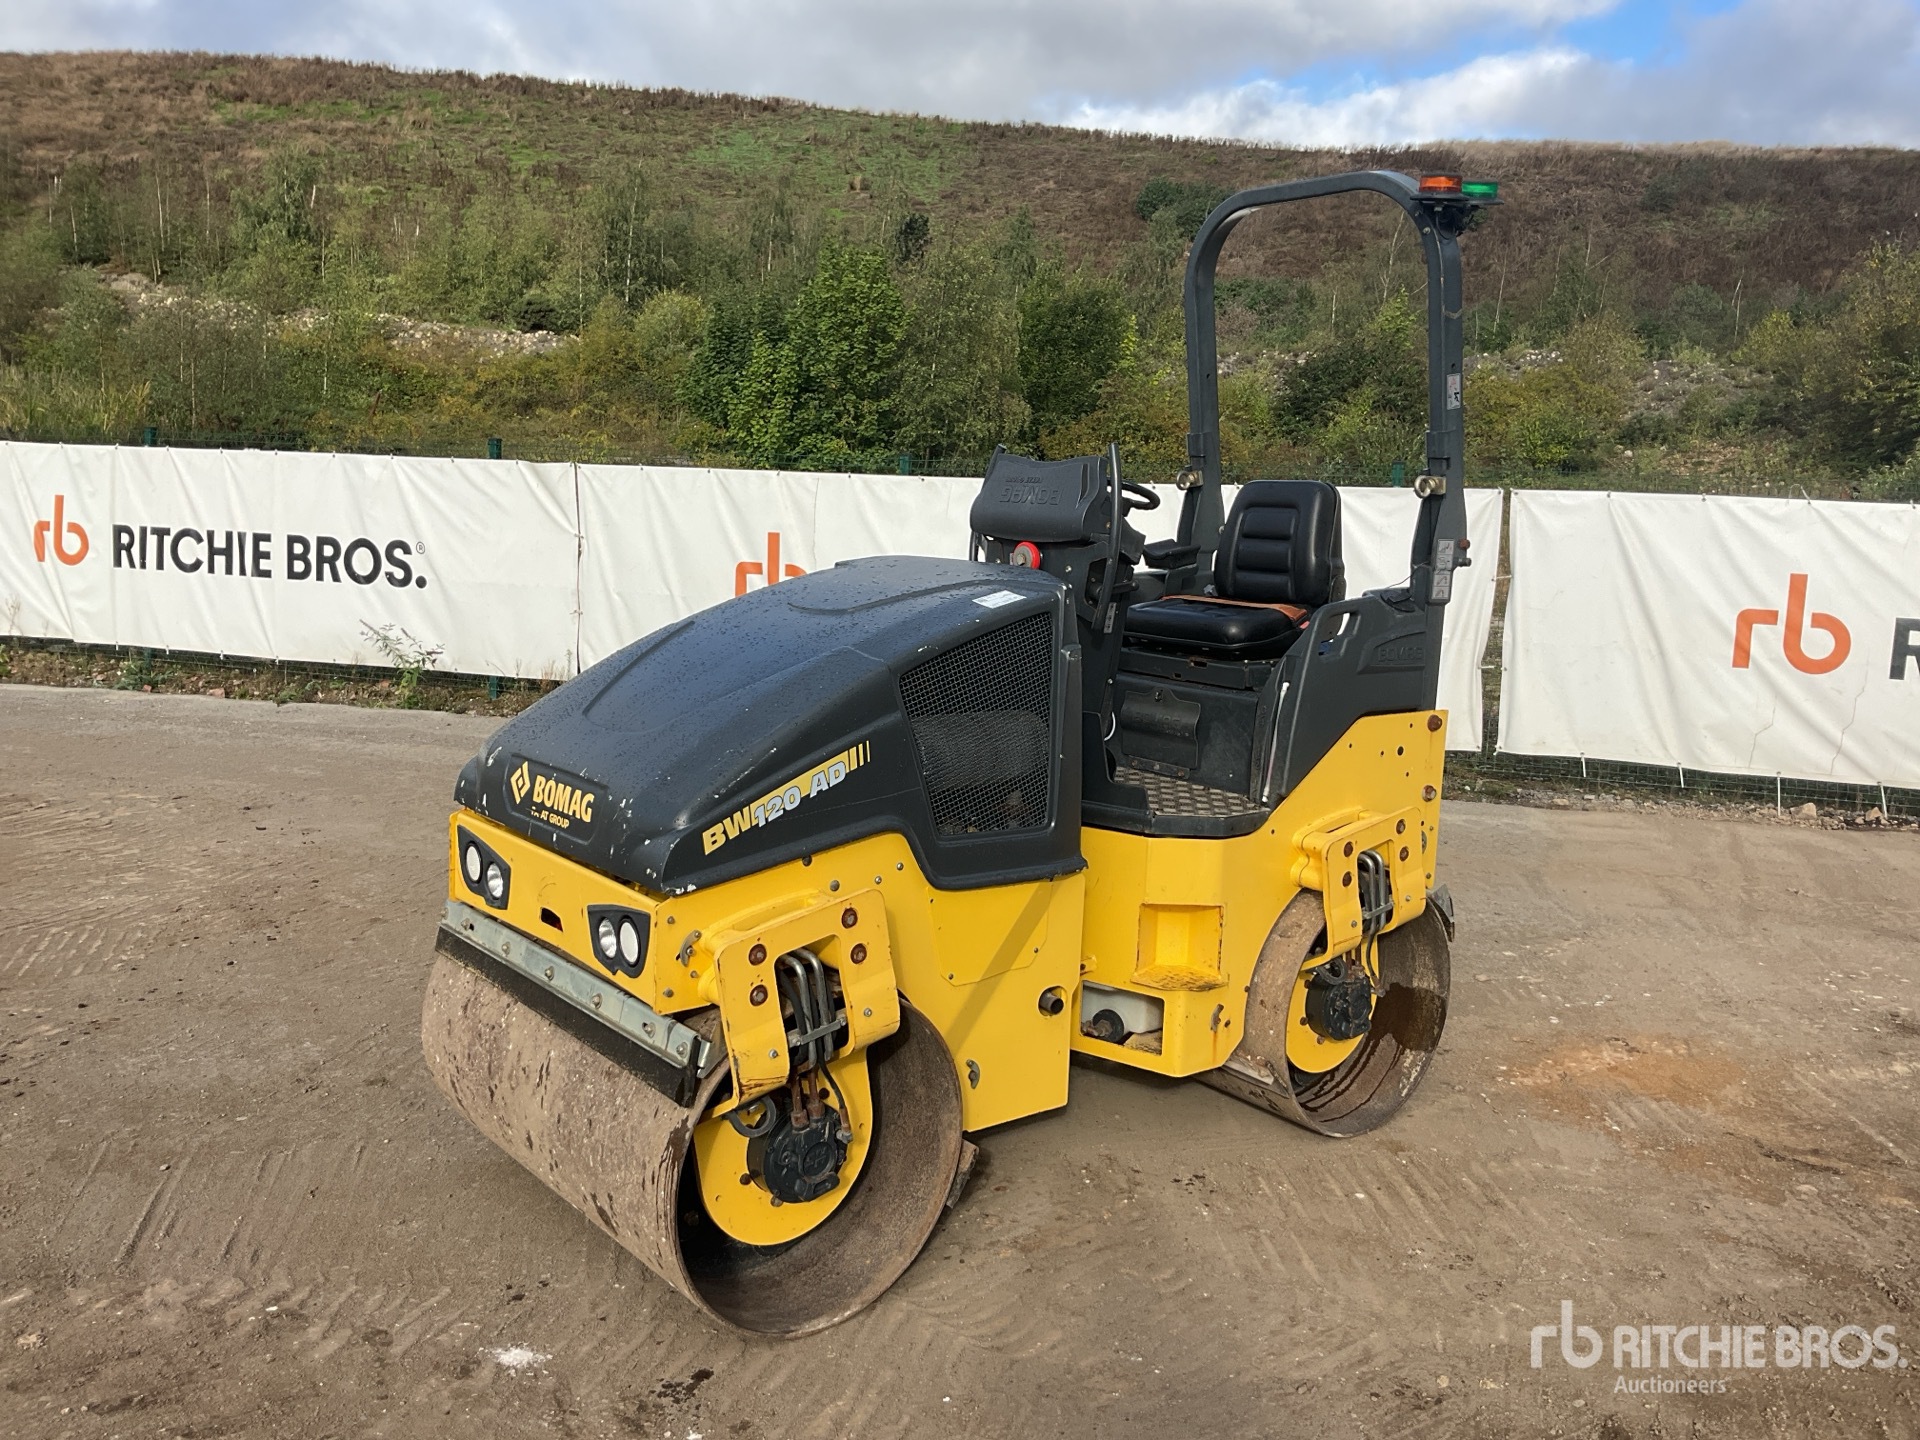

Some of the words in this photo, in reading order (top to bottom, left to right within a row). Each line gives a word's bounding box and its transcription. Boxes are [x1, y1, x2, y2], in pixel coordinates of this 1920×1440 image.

[112, 523, 272, 579] RITCHIE
[1888, 617, 1920, 681] R
[532, 774, 595, 823] BOMAG
[809, 760, 848, 799] AD
[548, 812, 571, 829] GROUP
